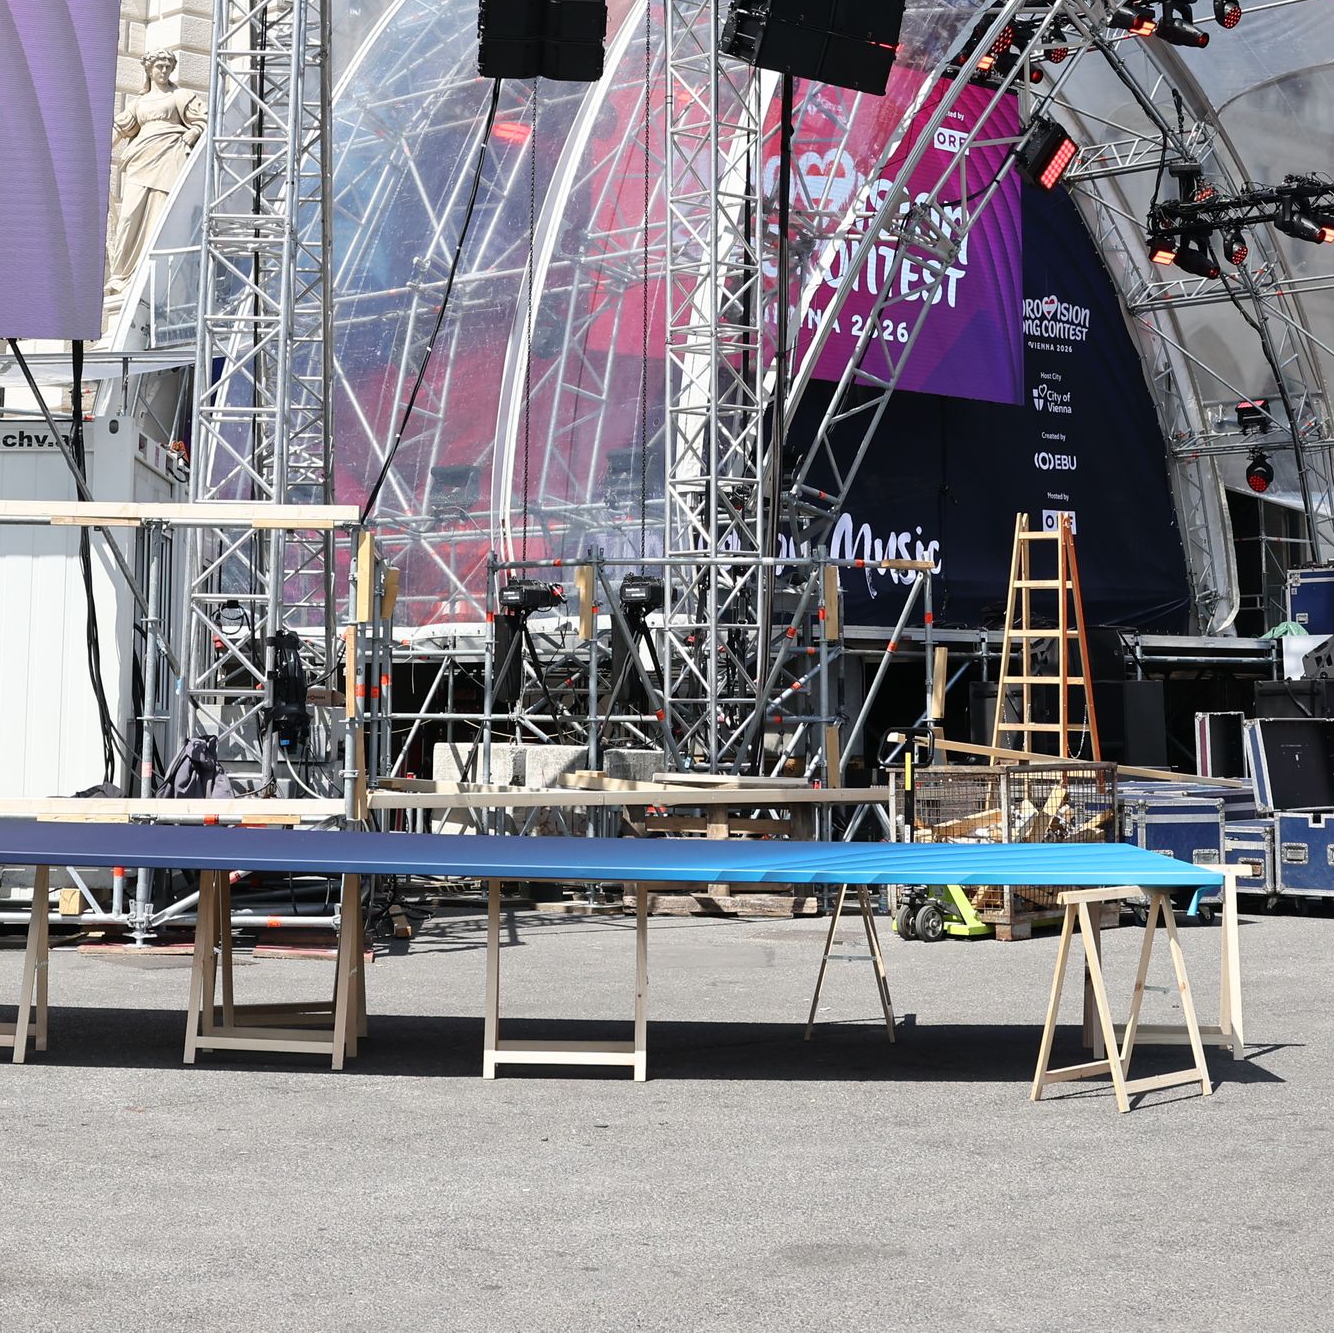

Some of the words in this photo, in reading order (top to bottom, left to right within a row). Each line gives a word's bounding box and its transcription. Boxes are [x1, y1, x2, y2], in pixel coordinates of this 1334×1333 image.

[1028, 341, 1055, 352] VIENNA
[1056, 344, 1073, 353] 2026
[1040, 372, 1052, 380] Host
[1052, 372, 1062, 381] City
[1047, 391, 1062, 404] City
[1062, 392, 1071, 402] of
[1047, 402, 1072, 413] Vienna
[1041, 432, 1059, 440] Created
[1047, 492, 1063, 500] Hosted
[830, 512, 942, 599] Music
